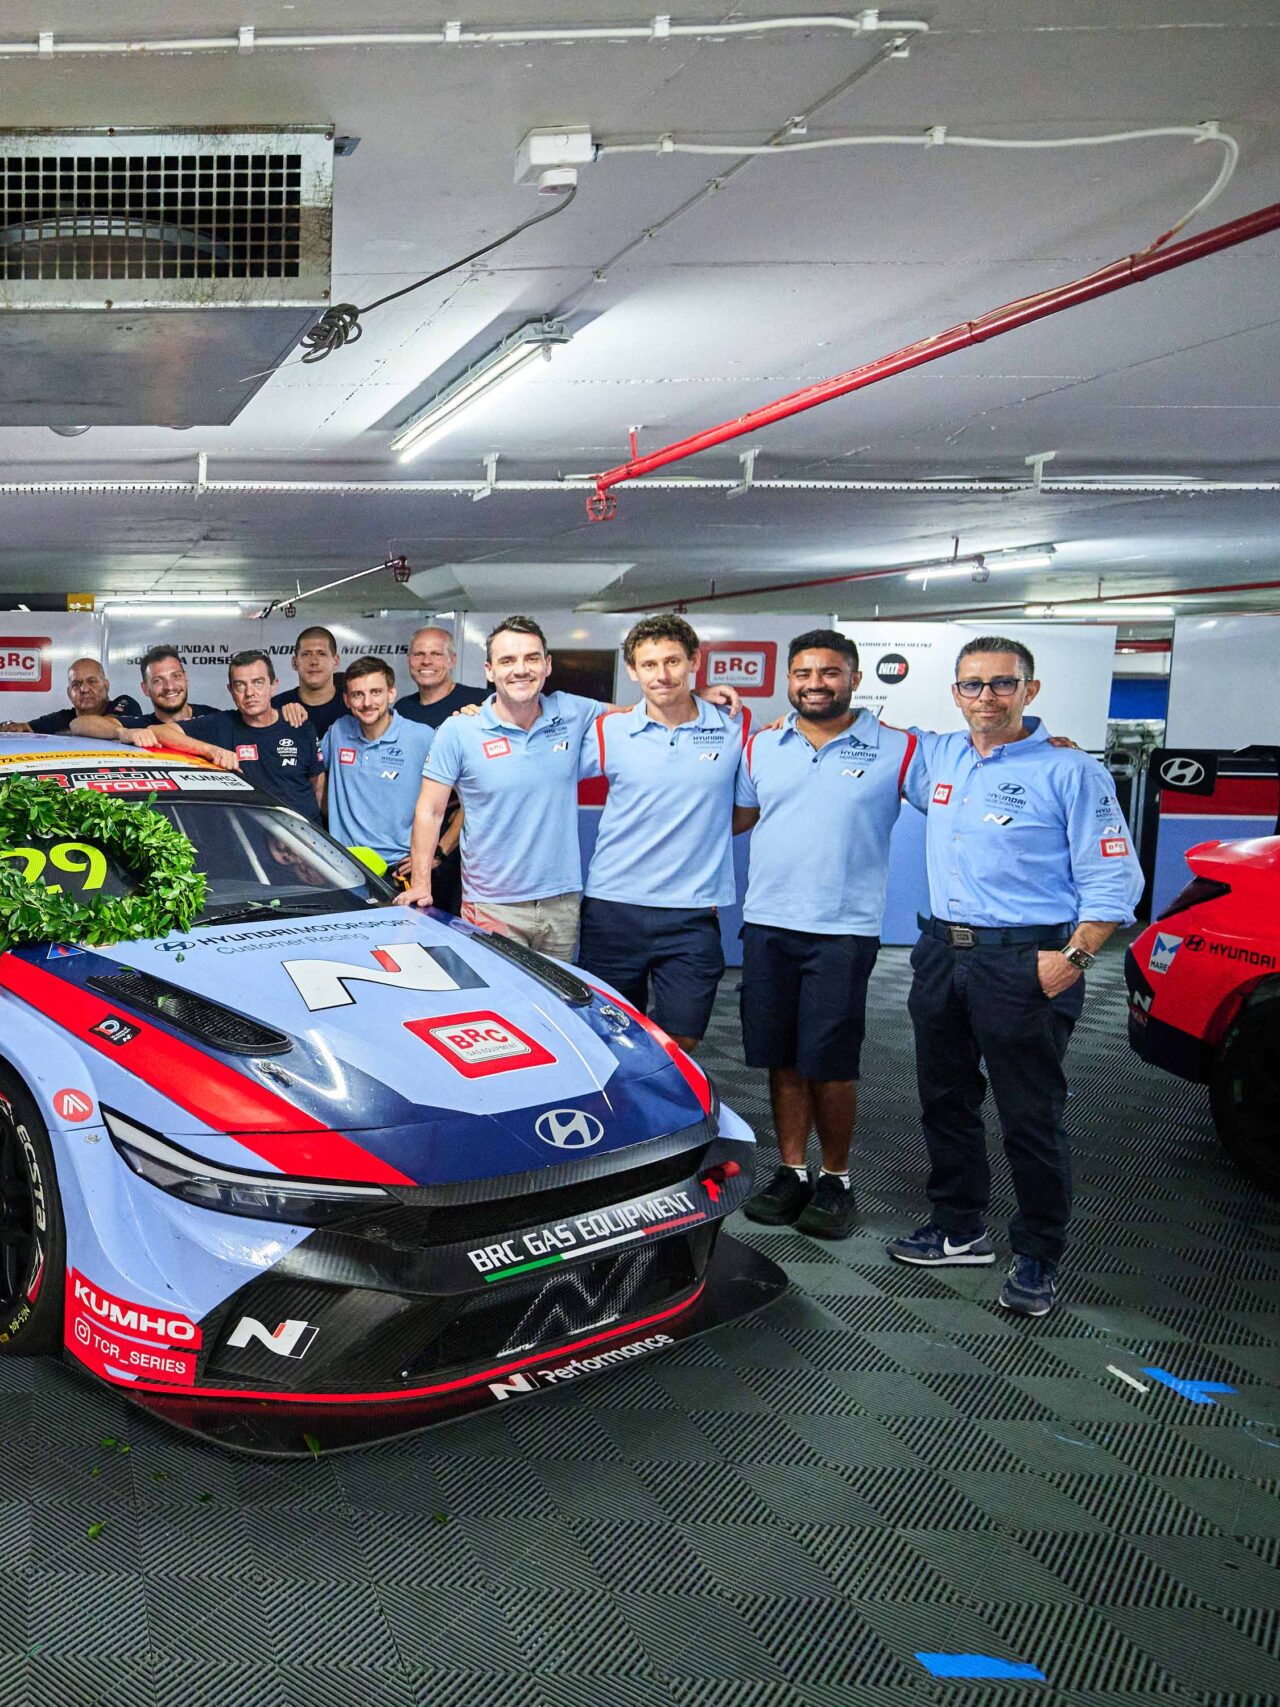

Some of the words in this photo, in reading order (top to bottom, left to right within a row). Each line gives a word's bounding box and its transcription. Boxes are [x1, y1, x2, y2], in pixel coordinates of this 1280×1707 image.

[192, 656, 233, 665] CORSE
[714, 657, 758, 675] BRC
[97, 781, 172, 791] TOUR
[180, 774, 238, 782] KUMHO
[0, 842, 107, 895] 29
[216, 937, 308, 955] Customer
[312, 930, 370, 945] Racing
[1209, 942, 1277, 969] HYUNDAI
[447, 1028, 509, 1050] BRC
[480, 1042, 518, 1055] EQUIPMENT
[467, 1239, 525, 1273] BRC
[522, 1223, 577, 1256] GAS
[574, 1191, 697, 1242] EQUIPMENT
[74, 1278, 196, 1340] KUMHO
[93, 1334, 187, 1375] TCR_SERIES
[537, 1333, 675, 1385] Performance
